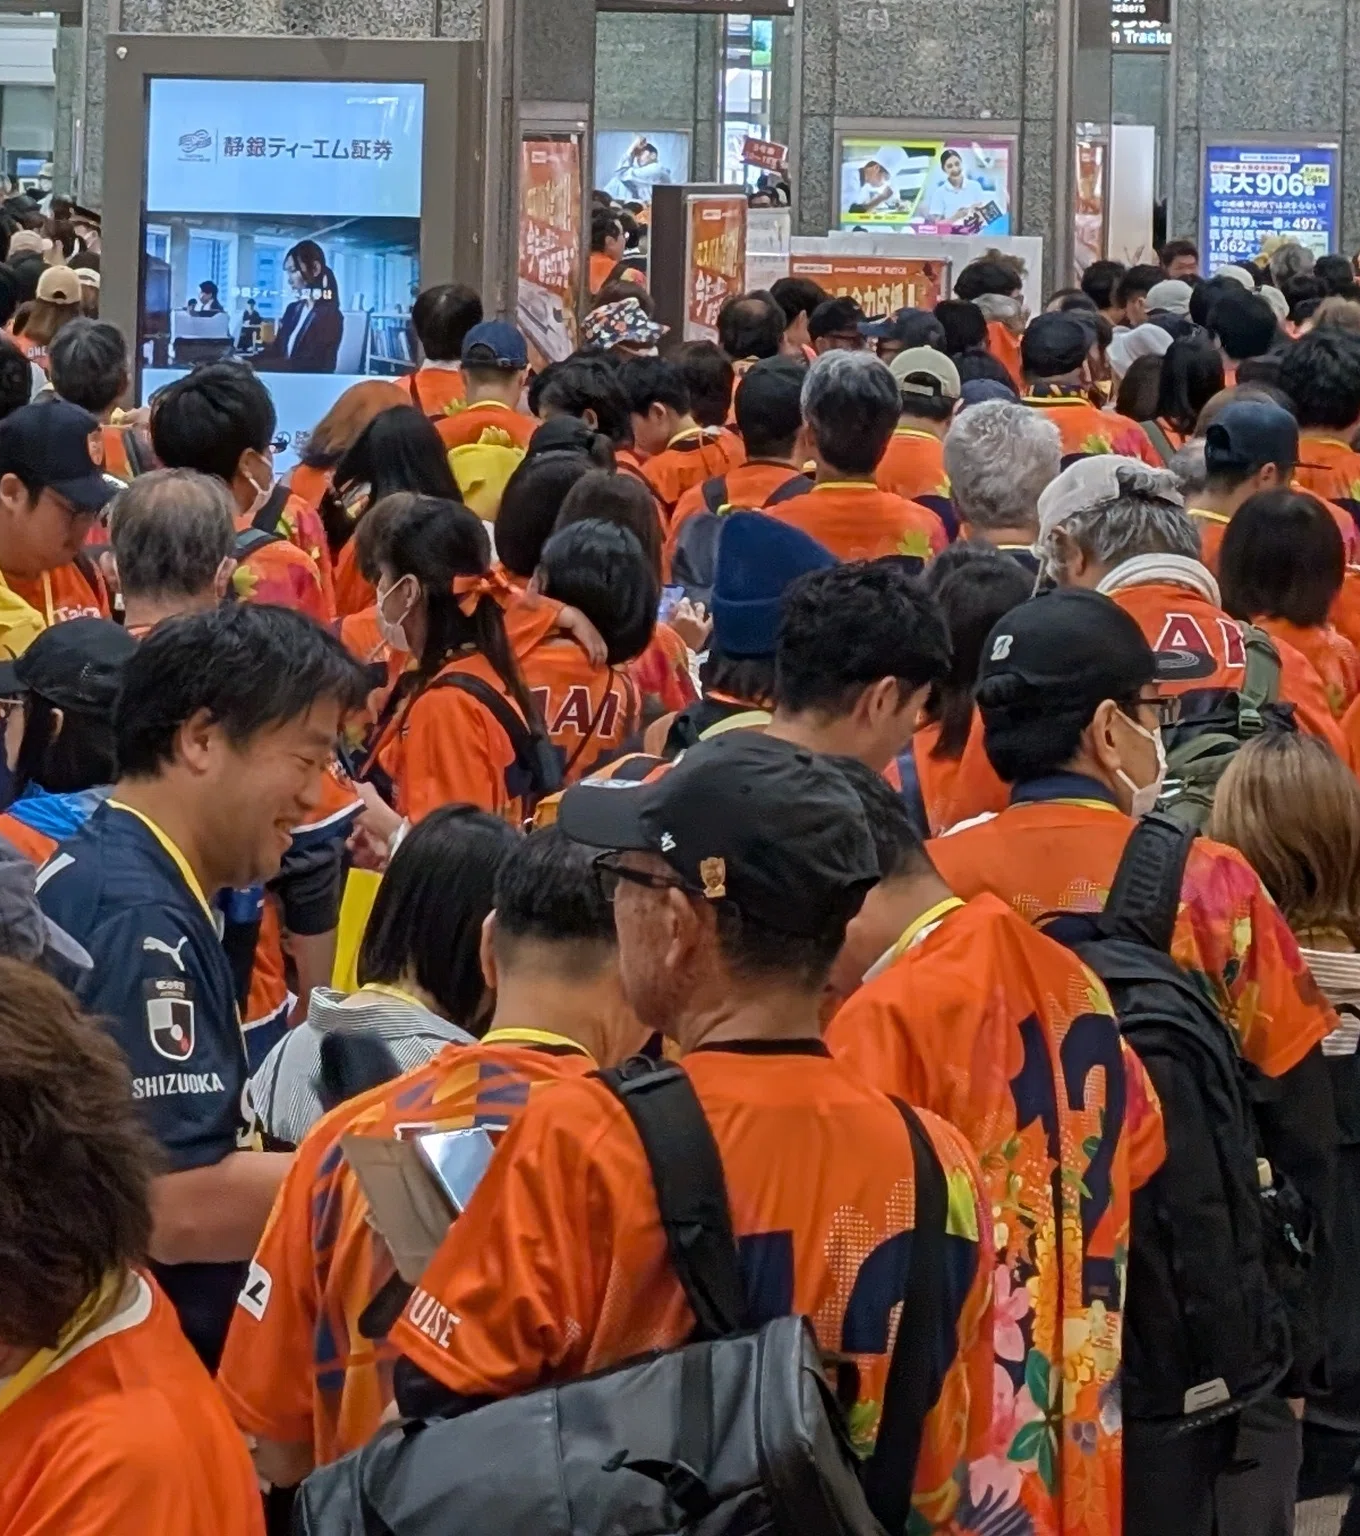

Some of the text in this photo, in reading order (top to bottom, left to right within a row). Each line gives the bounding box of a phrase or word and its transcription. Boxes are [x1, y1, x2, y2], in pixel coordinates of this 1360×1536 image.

[223, 135, 393, 161] 静銀ティーエム証券
[132, 1072, 226, 1100] SHIZUOKA
